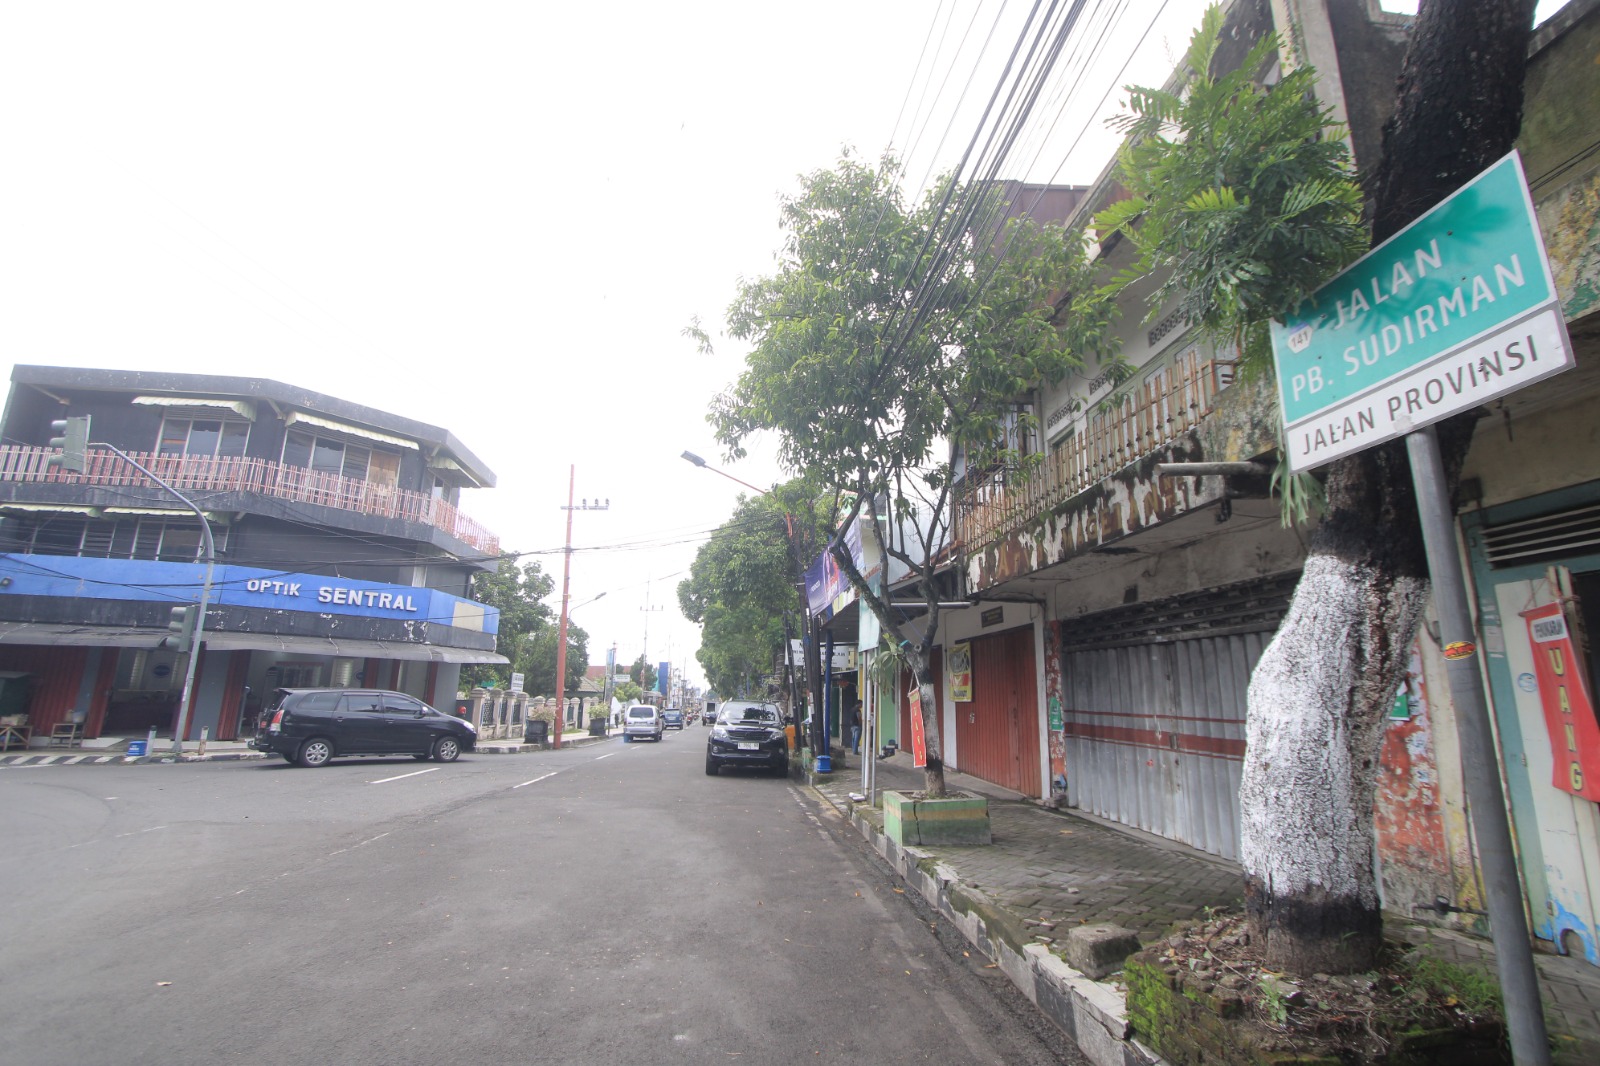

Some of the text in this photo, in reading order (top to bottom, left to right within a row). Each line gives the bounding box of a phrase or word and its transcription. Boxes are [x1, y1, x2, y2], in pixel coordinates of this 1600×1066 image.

[1291, 254, 1525, 402] PB. SUDIRMAN
[1334, 239, 1442, 330] JALAN
[1290, 330, 1309, 348] 141
[1302, 335, 1538, 455] JALAN PROVINSI
[247, 579, 418, 612] OPTIK SENTRAL
[1549, 647, 1583, 791] UANG
